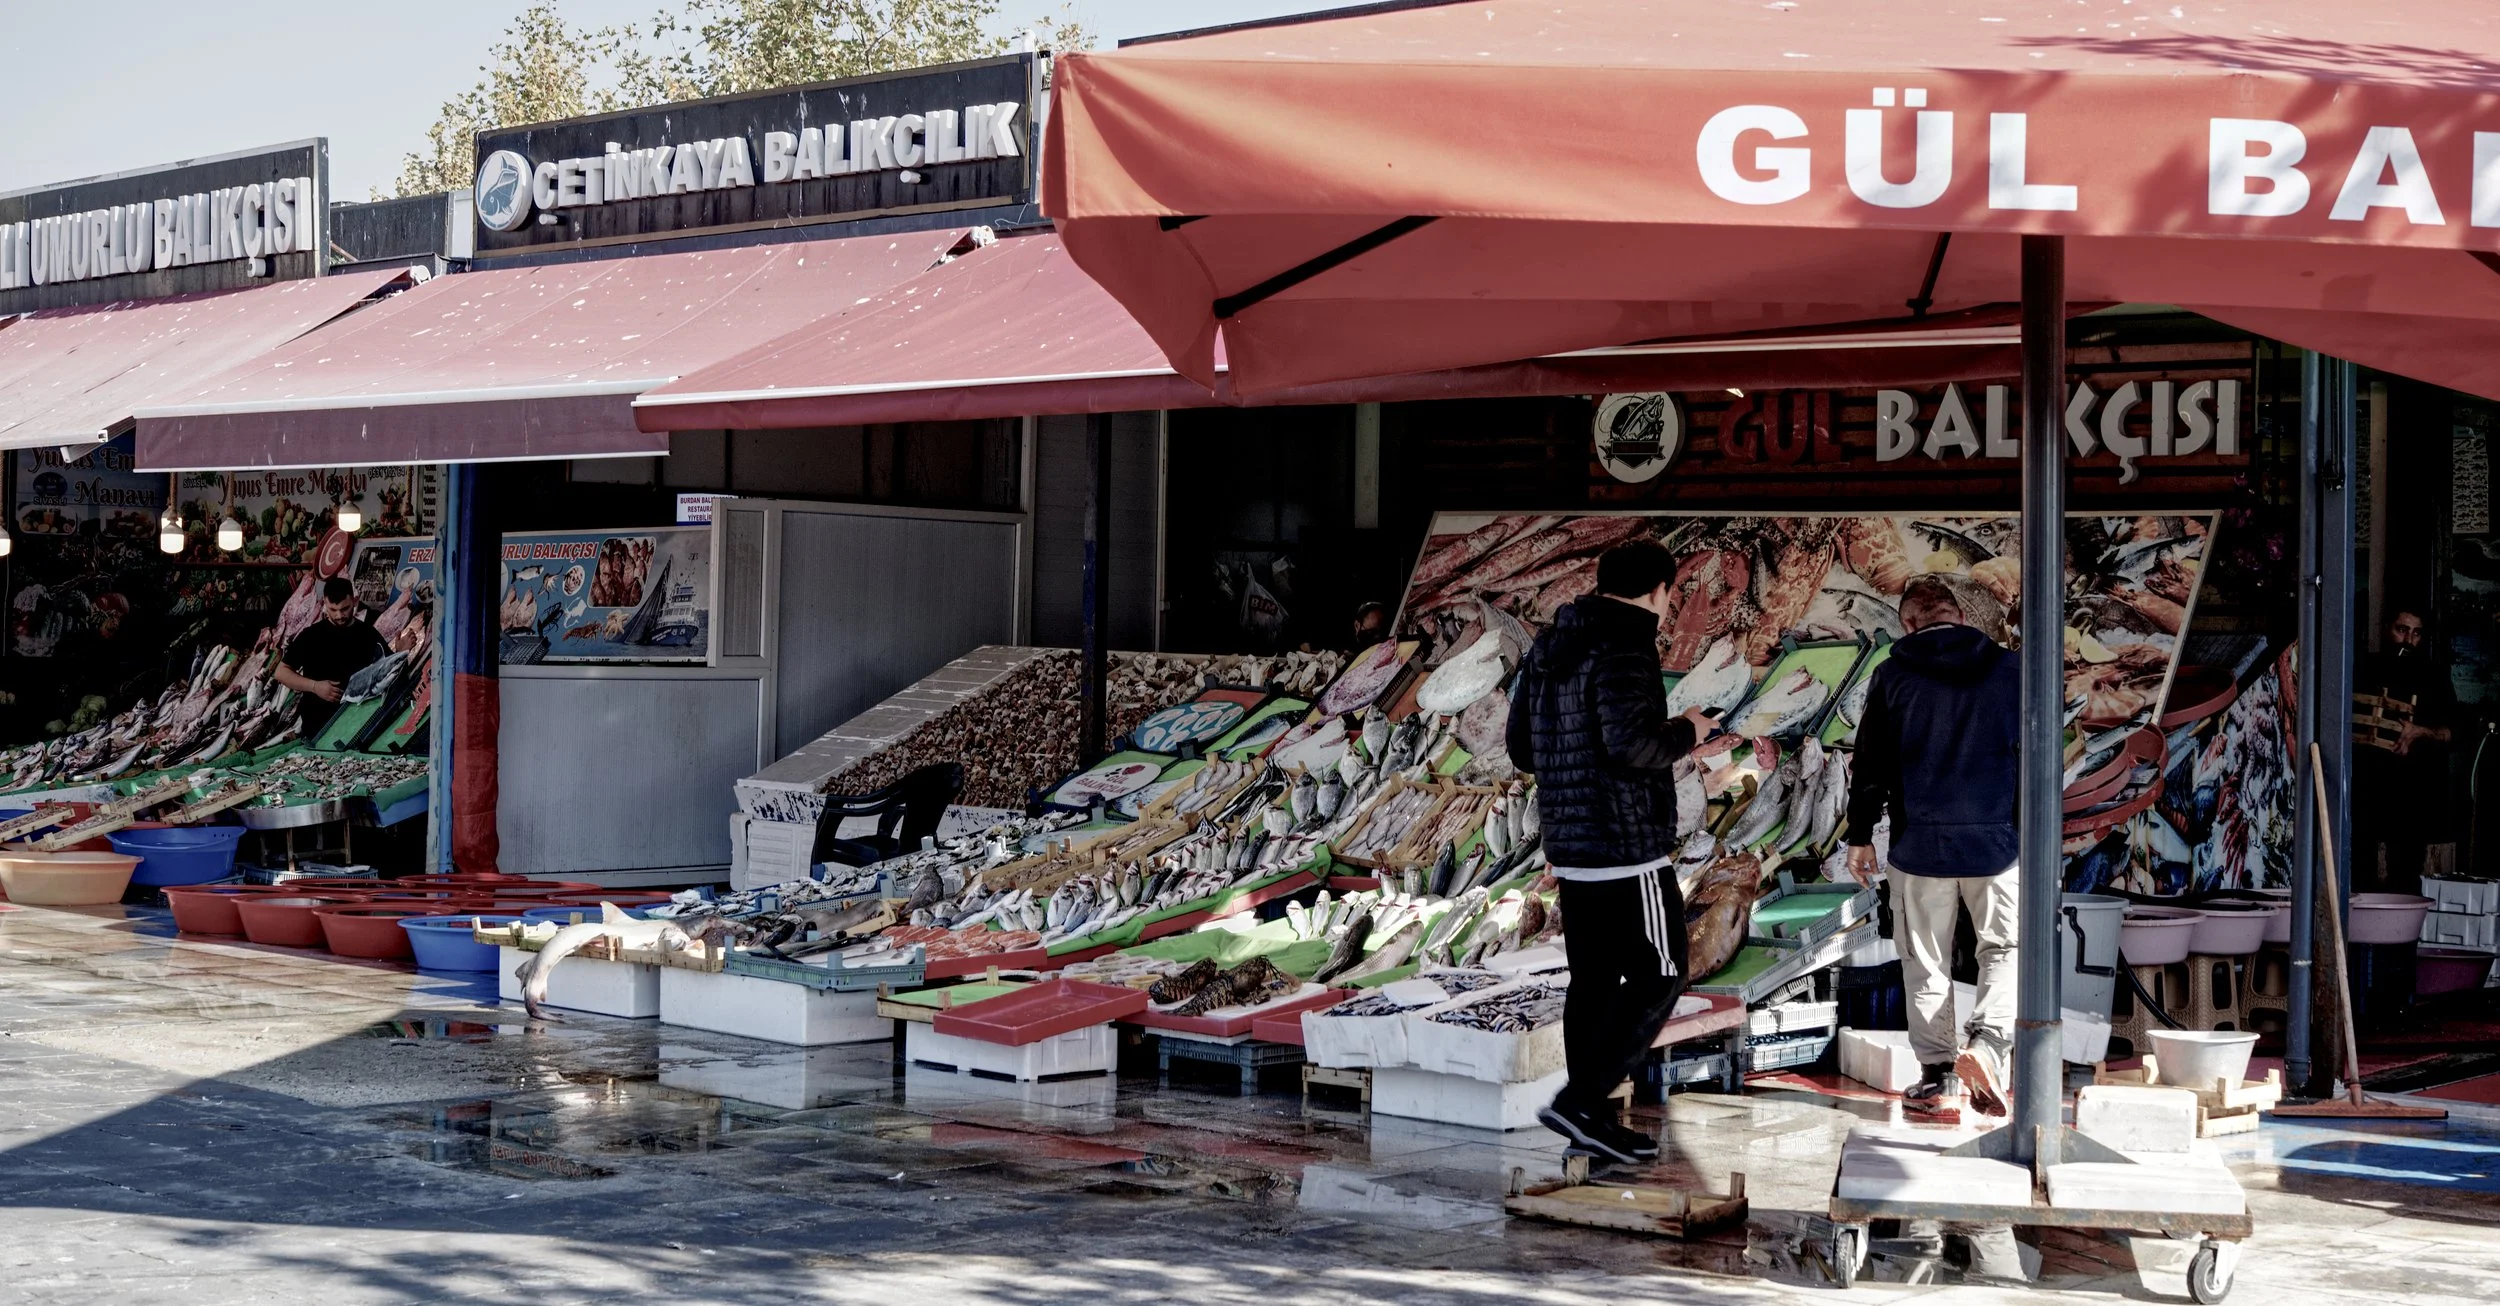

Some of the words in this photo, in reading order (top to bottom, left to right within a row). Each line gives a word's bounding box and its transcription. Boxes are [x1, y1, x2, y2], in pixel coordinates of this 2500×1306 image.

[1696, 87, 2079, 212] GÜL
[533, 135, 756, 225] ÇETİNKAYA
[764, 101, 1021, 184] BALIKÇILIK
[0, 222, 30, 289] LI
[31, 201, 153, 286] UMURLU
[154, 176, 313, 277] BALIKÇISI
[1876, 380, 2242, 485] BALKÇISI
[28, 447, 95, 473] Yuus
[264, 471, 305, 497] Emre
[687, 505, 712, 513] RESTAURA
[687, 513, 712, 521] YİYEBİLİR
[533, 541, 599, 563] BALIKÇISI
